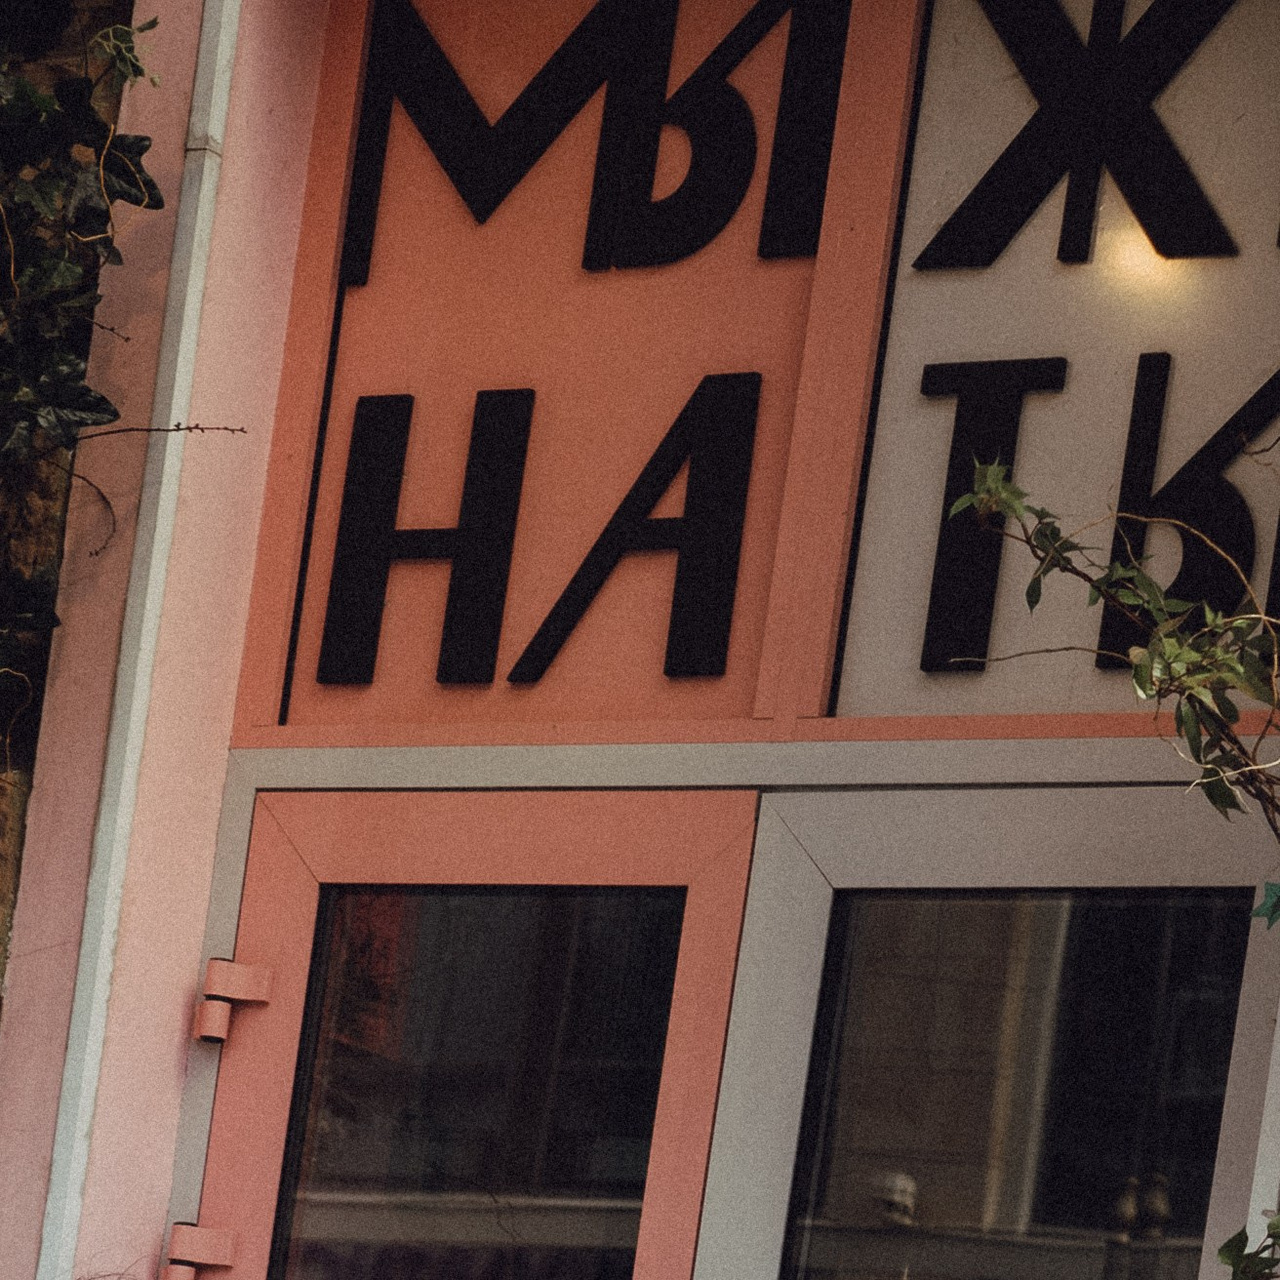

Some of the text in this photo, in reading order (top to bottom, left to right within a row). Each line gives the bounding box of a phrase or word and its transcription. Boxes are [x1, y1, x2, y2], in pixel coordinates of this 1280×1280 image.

[340, 0, 852, 287] МЫ
[911, 0, 1280, 269] Ж
[317, 372, 763, 685] НА
